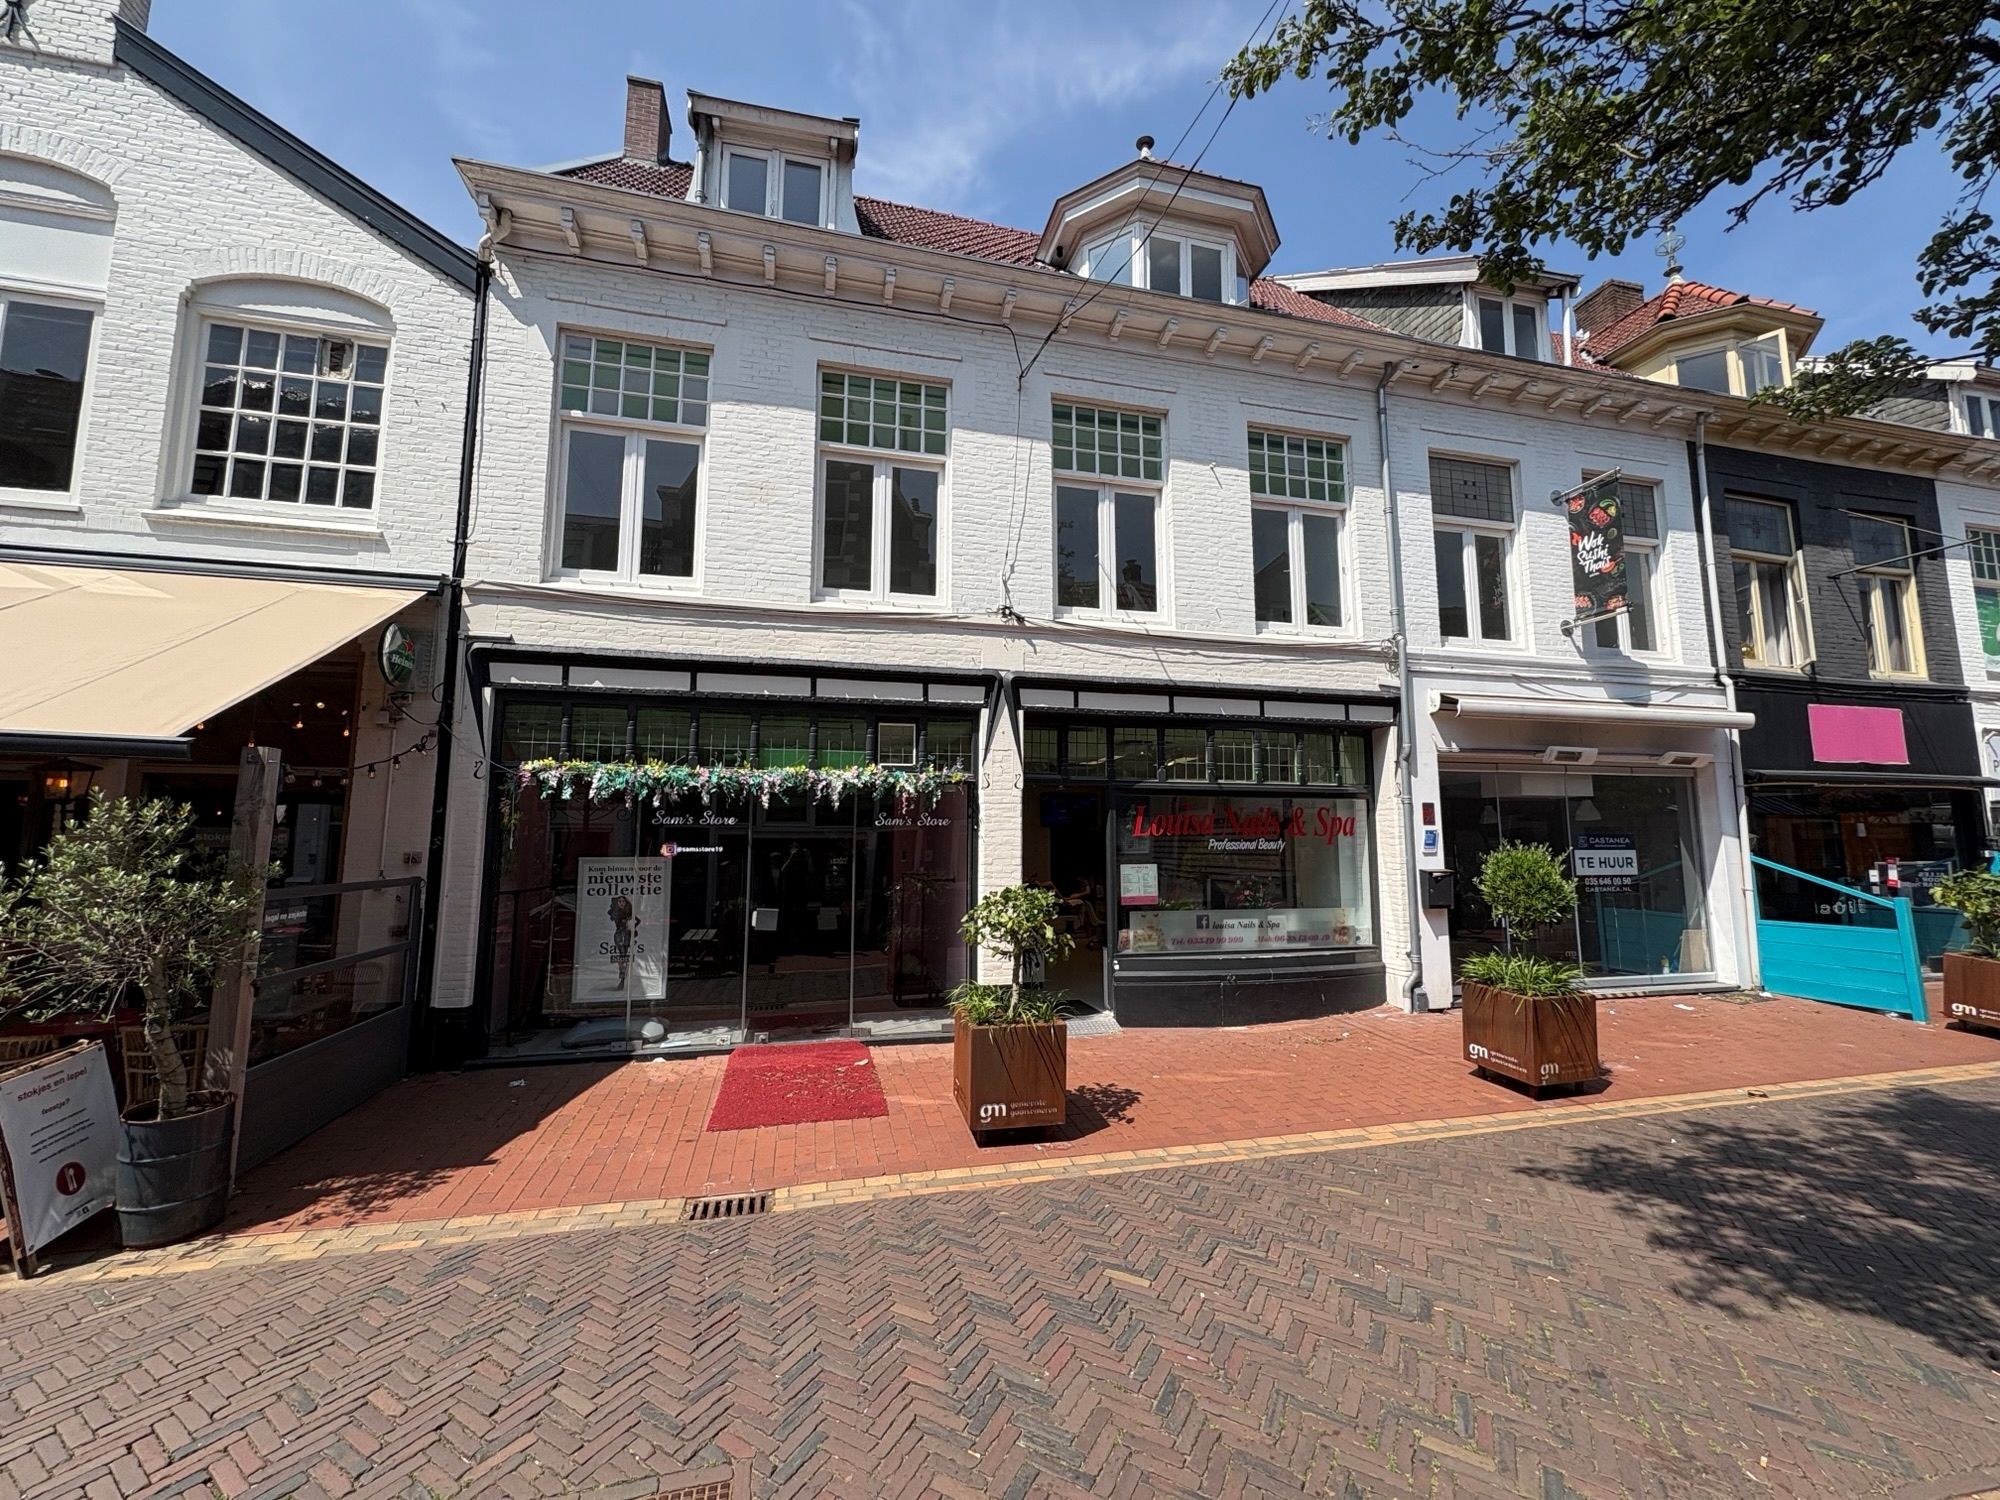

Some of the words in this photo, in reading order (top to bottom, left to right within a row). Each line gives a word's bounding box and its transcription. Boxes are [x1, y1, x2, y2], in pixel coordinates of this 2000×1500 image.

[1577, 531, 1605, 551] Wok
[1577, 543, 1609, 564] Sushi
[651, 810, 694, 825] Sam's
[699, 810, 738, 825] Store
[875, 812, 912, 826] Sam's
[917, 812, 951, 826] Store
[1131, 805, 1214, 837] Louisa
[1220, 806, 1281, 836] Nails
[1288, 806, 1307, 836] &
[1314, 807, 1357, 845] Spa
[1208, 838, 1257, 851] Professional
[1258, 838, 1286, 852] Beauty
[1578, 857, 1595, 868] TE
[1599, 857, 1634, 868] HUUR
[1584, 877, 1598, 886] 035
[1622, 877, 1632, 885] 50
[586, 884, 662, 896] collectie
[1237, 919, 1256, 929] Nails
[1258, 920, 1264, 929] &
[1267, 920, 1280, 930] Spa
[600, 941, 645, 955] Sa's
[1951, 1003, 1977, 1016] gm
[1469, 1043, 1489, 1059] gm
[1541, 1063, 1559, 1079] gm
[18, 1082, 52, 1102] stokjes
[54, 1078, 65, 1087] en
[67, 1067, 88, 1081] lepel
[980, 1103, 1007, 1124] gm
